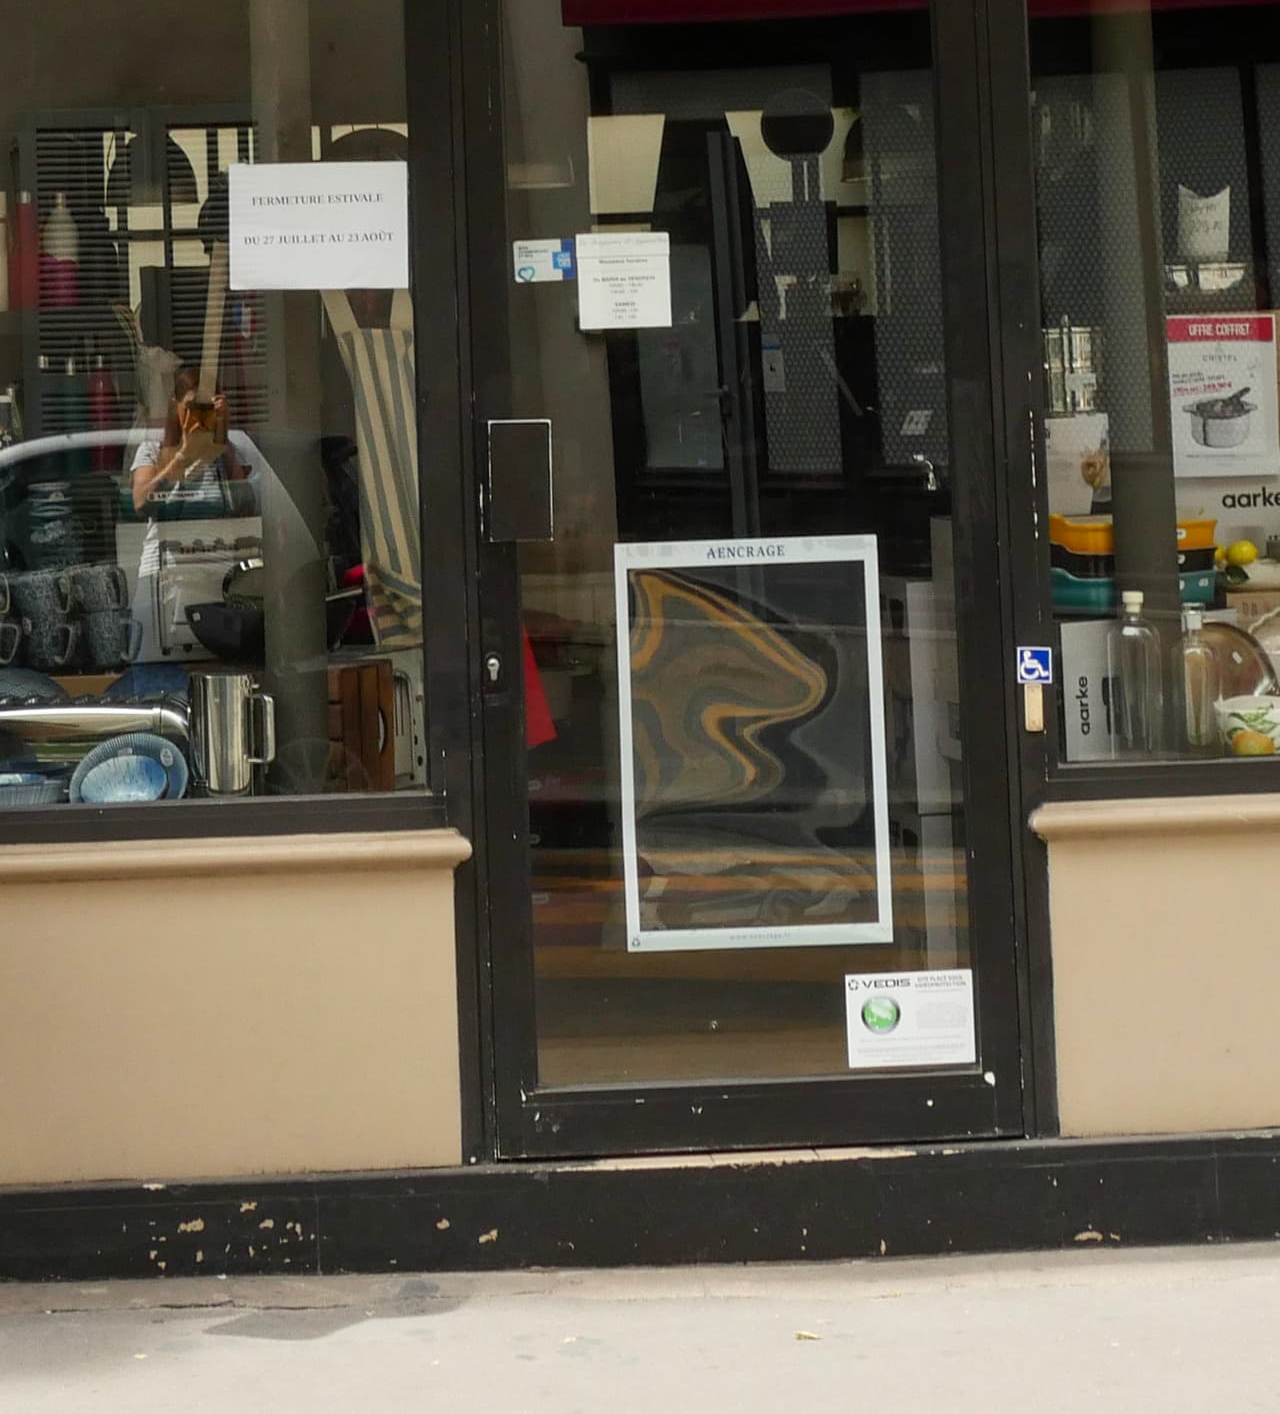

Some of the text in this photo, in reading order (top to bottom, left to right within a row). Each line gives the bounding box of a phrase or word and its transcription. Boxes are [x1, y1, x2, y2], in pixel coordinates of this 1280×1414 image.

[251, 192, 384, 207] FERMETURE ESTIVALE
[243, 236, 260, 246] DU
[263, 235, 275, 245] 27
[277, 233, 328, 245] JUILLET
[328, 232, 346, 244] AU
[360, 230, 394, 243] AOÛT
[1215, 323, 1250, 336] COFFRET
[706, 544, 787, 560] AENCRAGE
[1075, 676, 1091, 736] aarke
[861, 977, 912, 989] VEDIS
